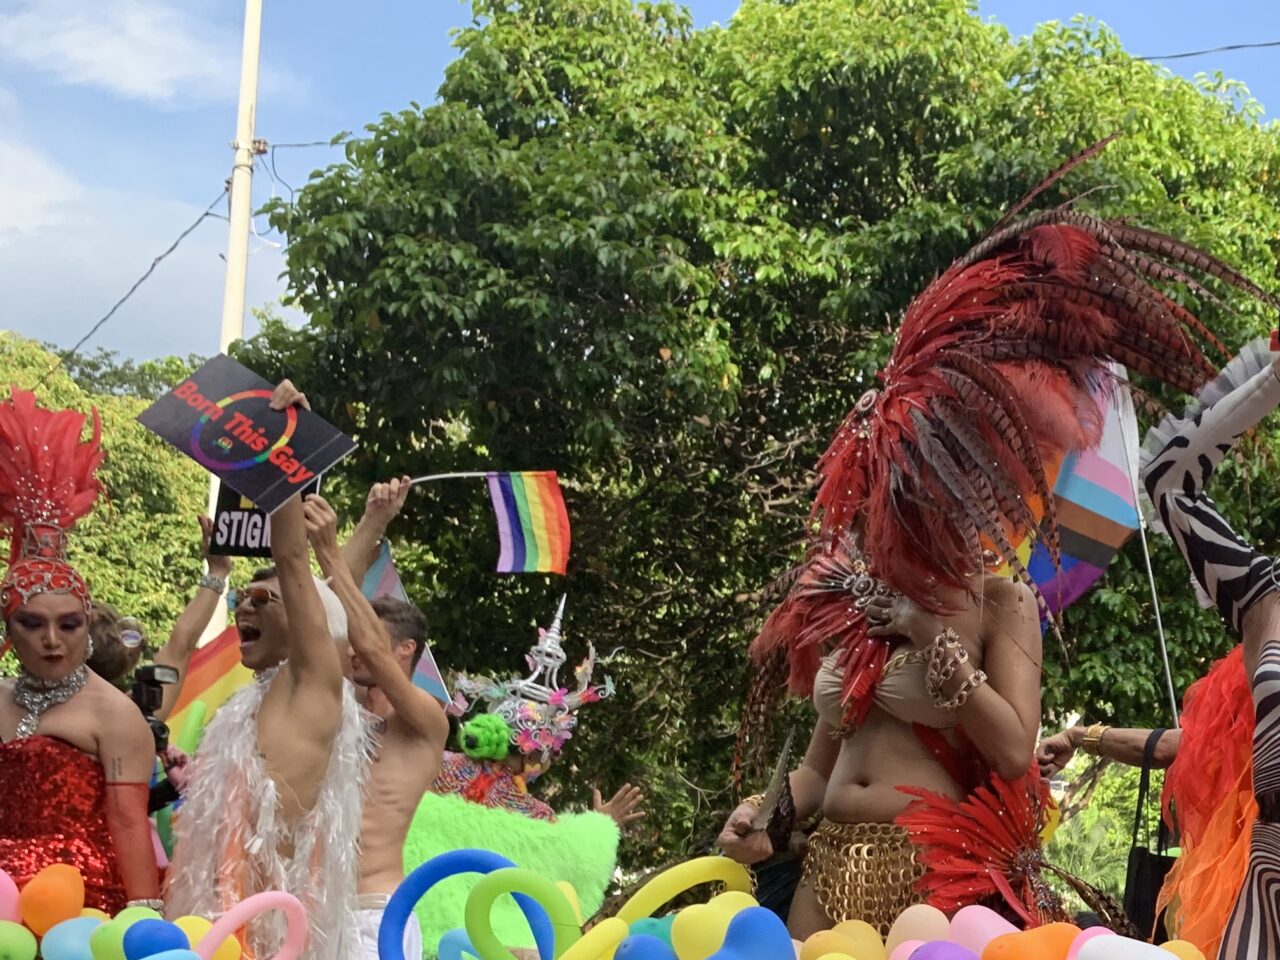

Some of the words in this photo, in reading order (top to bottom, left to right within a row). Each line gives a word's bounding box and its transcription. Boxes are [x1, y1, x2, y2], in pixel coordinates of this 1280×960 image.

[173, 380, 225, 422] Born
[224, 412, 269, 451] This
[269, 446, 316, 484] Gay
